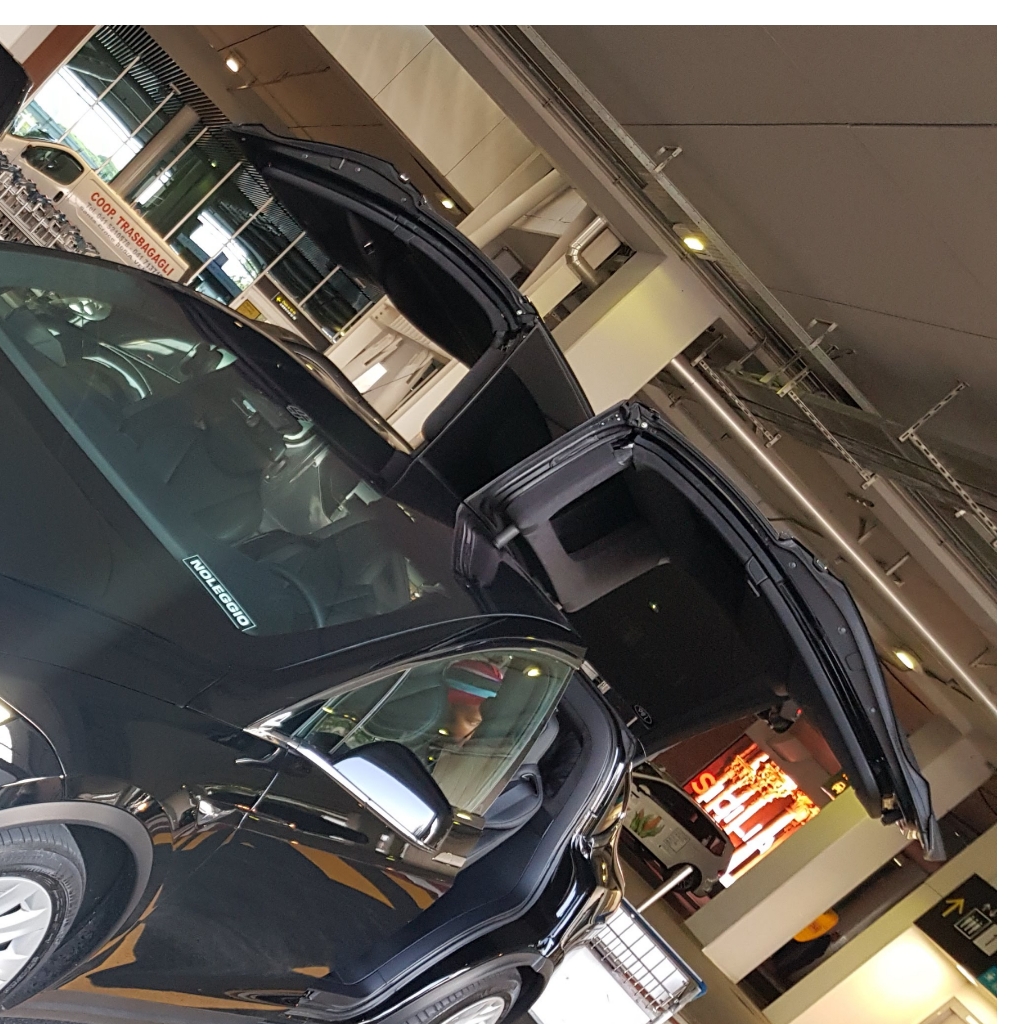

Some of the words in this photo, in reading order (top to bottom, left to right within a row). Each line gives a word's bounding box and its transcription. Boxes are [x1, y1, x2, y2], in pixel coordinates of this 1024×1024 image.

[90, 192, 117, 220] COOP.
[116, 216, 175, 276] TRASBAGAGLI
[190, 559, 250, 626] NOLEGGIO
